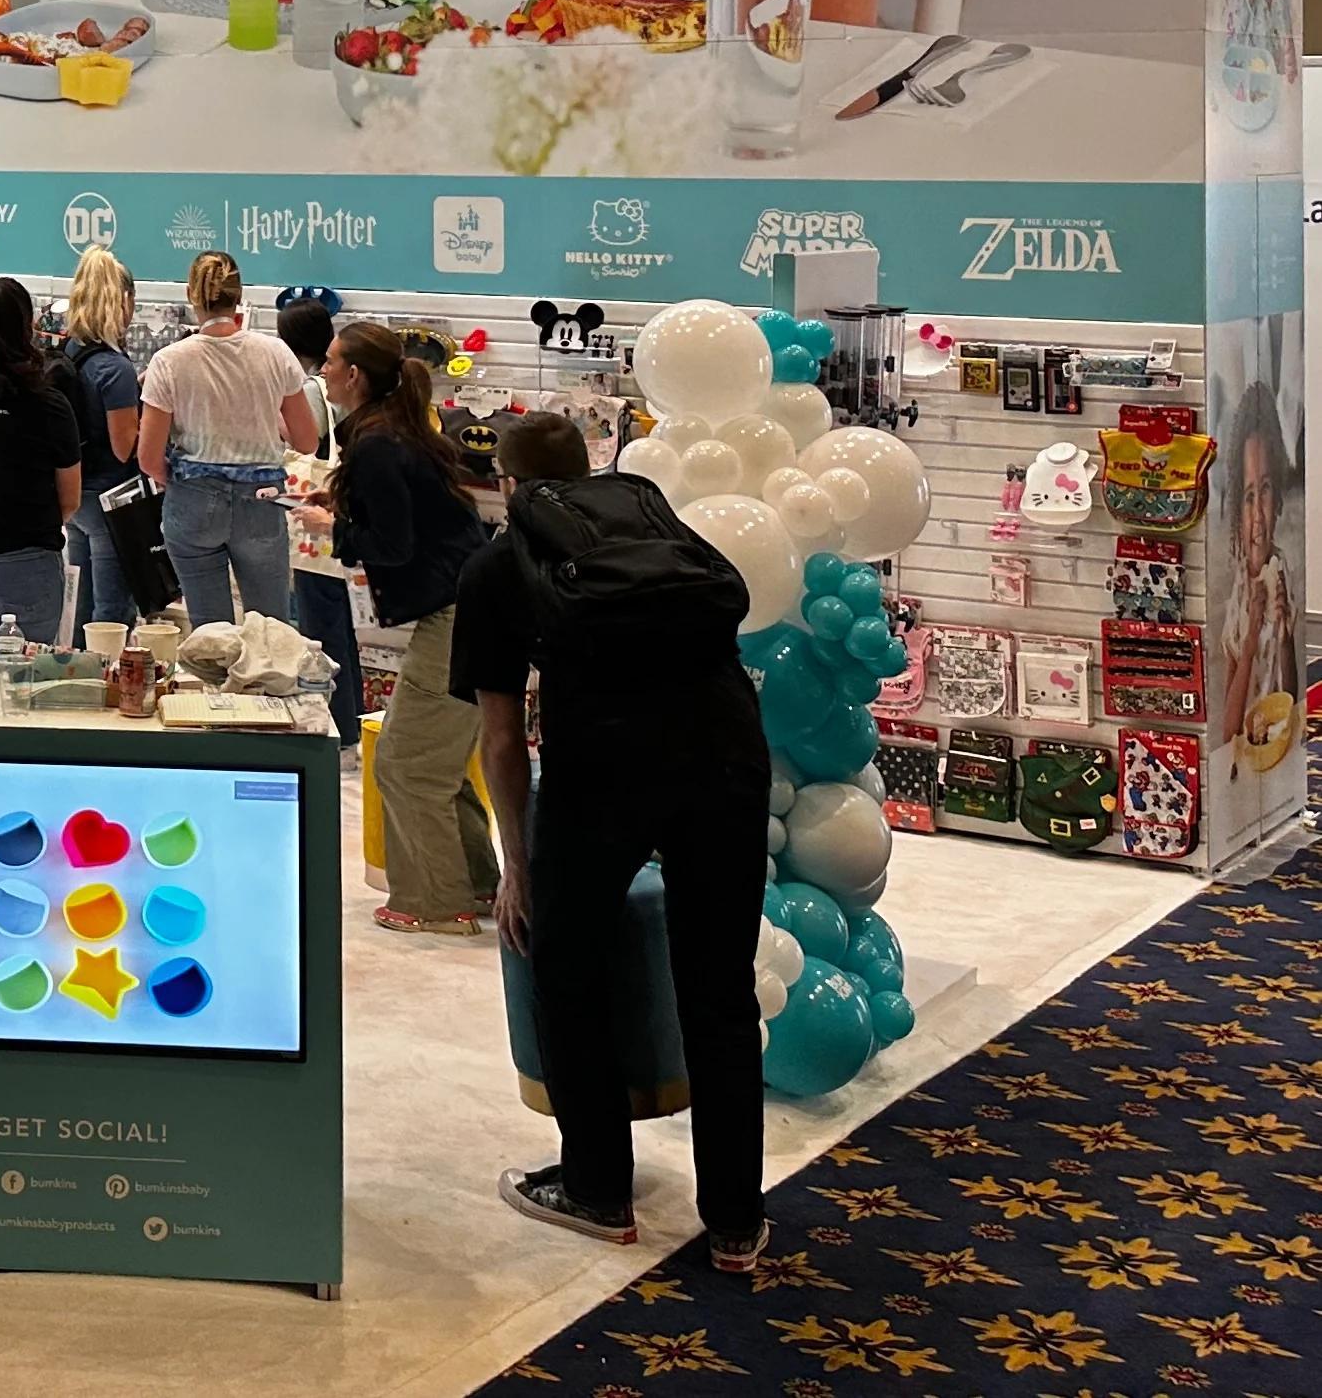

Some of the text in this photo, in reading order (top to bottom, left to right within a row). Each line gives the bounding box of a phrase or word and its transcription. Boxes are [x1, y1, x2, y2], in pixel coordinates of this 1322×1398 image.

[67, 207, 112, 244] DC
[237, 201, 377, 259] Harry Potter
[758, 209, 864, 239] SUPER
[1020, 218, 1104, 228] THE LEGEND OF
[165, 228, 216, 239] WIZARDING
[171, 238, 212, 250] WORLD
[959, 217, 1123, 281] ZELDA
[455, 252, 482, 265] baby
[565, 251, 613, 264] HELLO
[58, 1119, 168, 1144] SOCIAL!
[30, 1176, 77, 1190] bumkins
[134, 1181, 210, 1198] bumkinsbaby
[173, 1222, 221, 1237] bumkins
